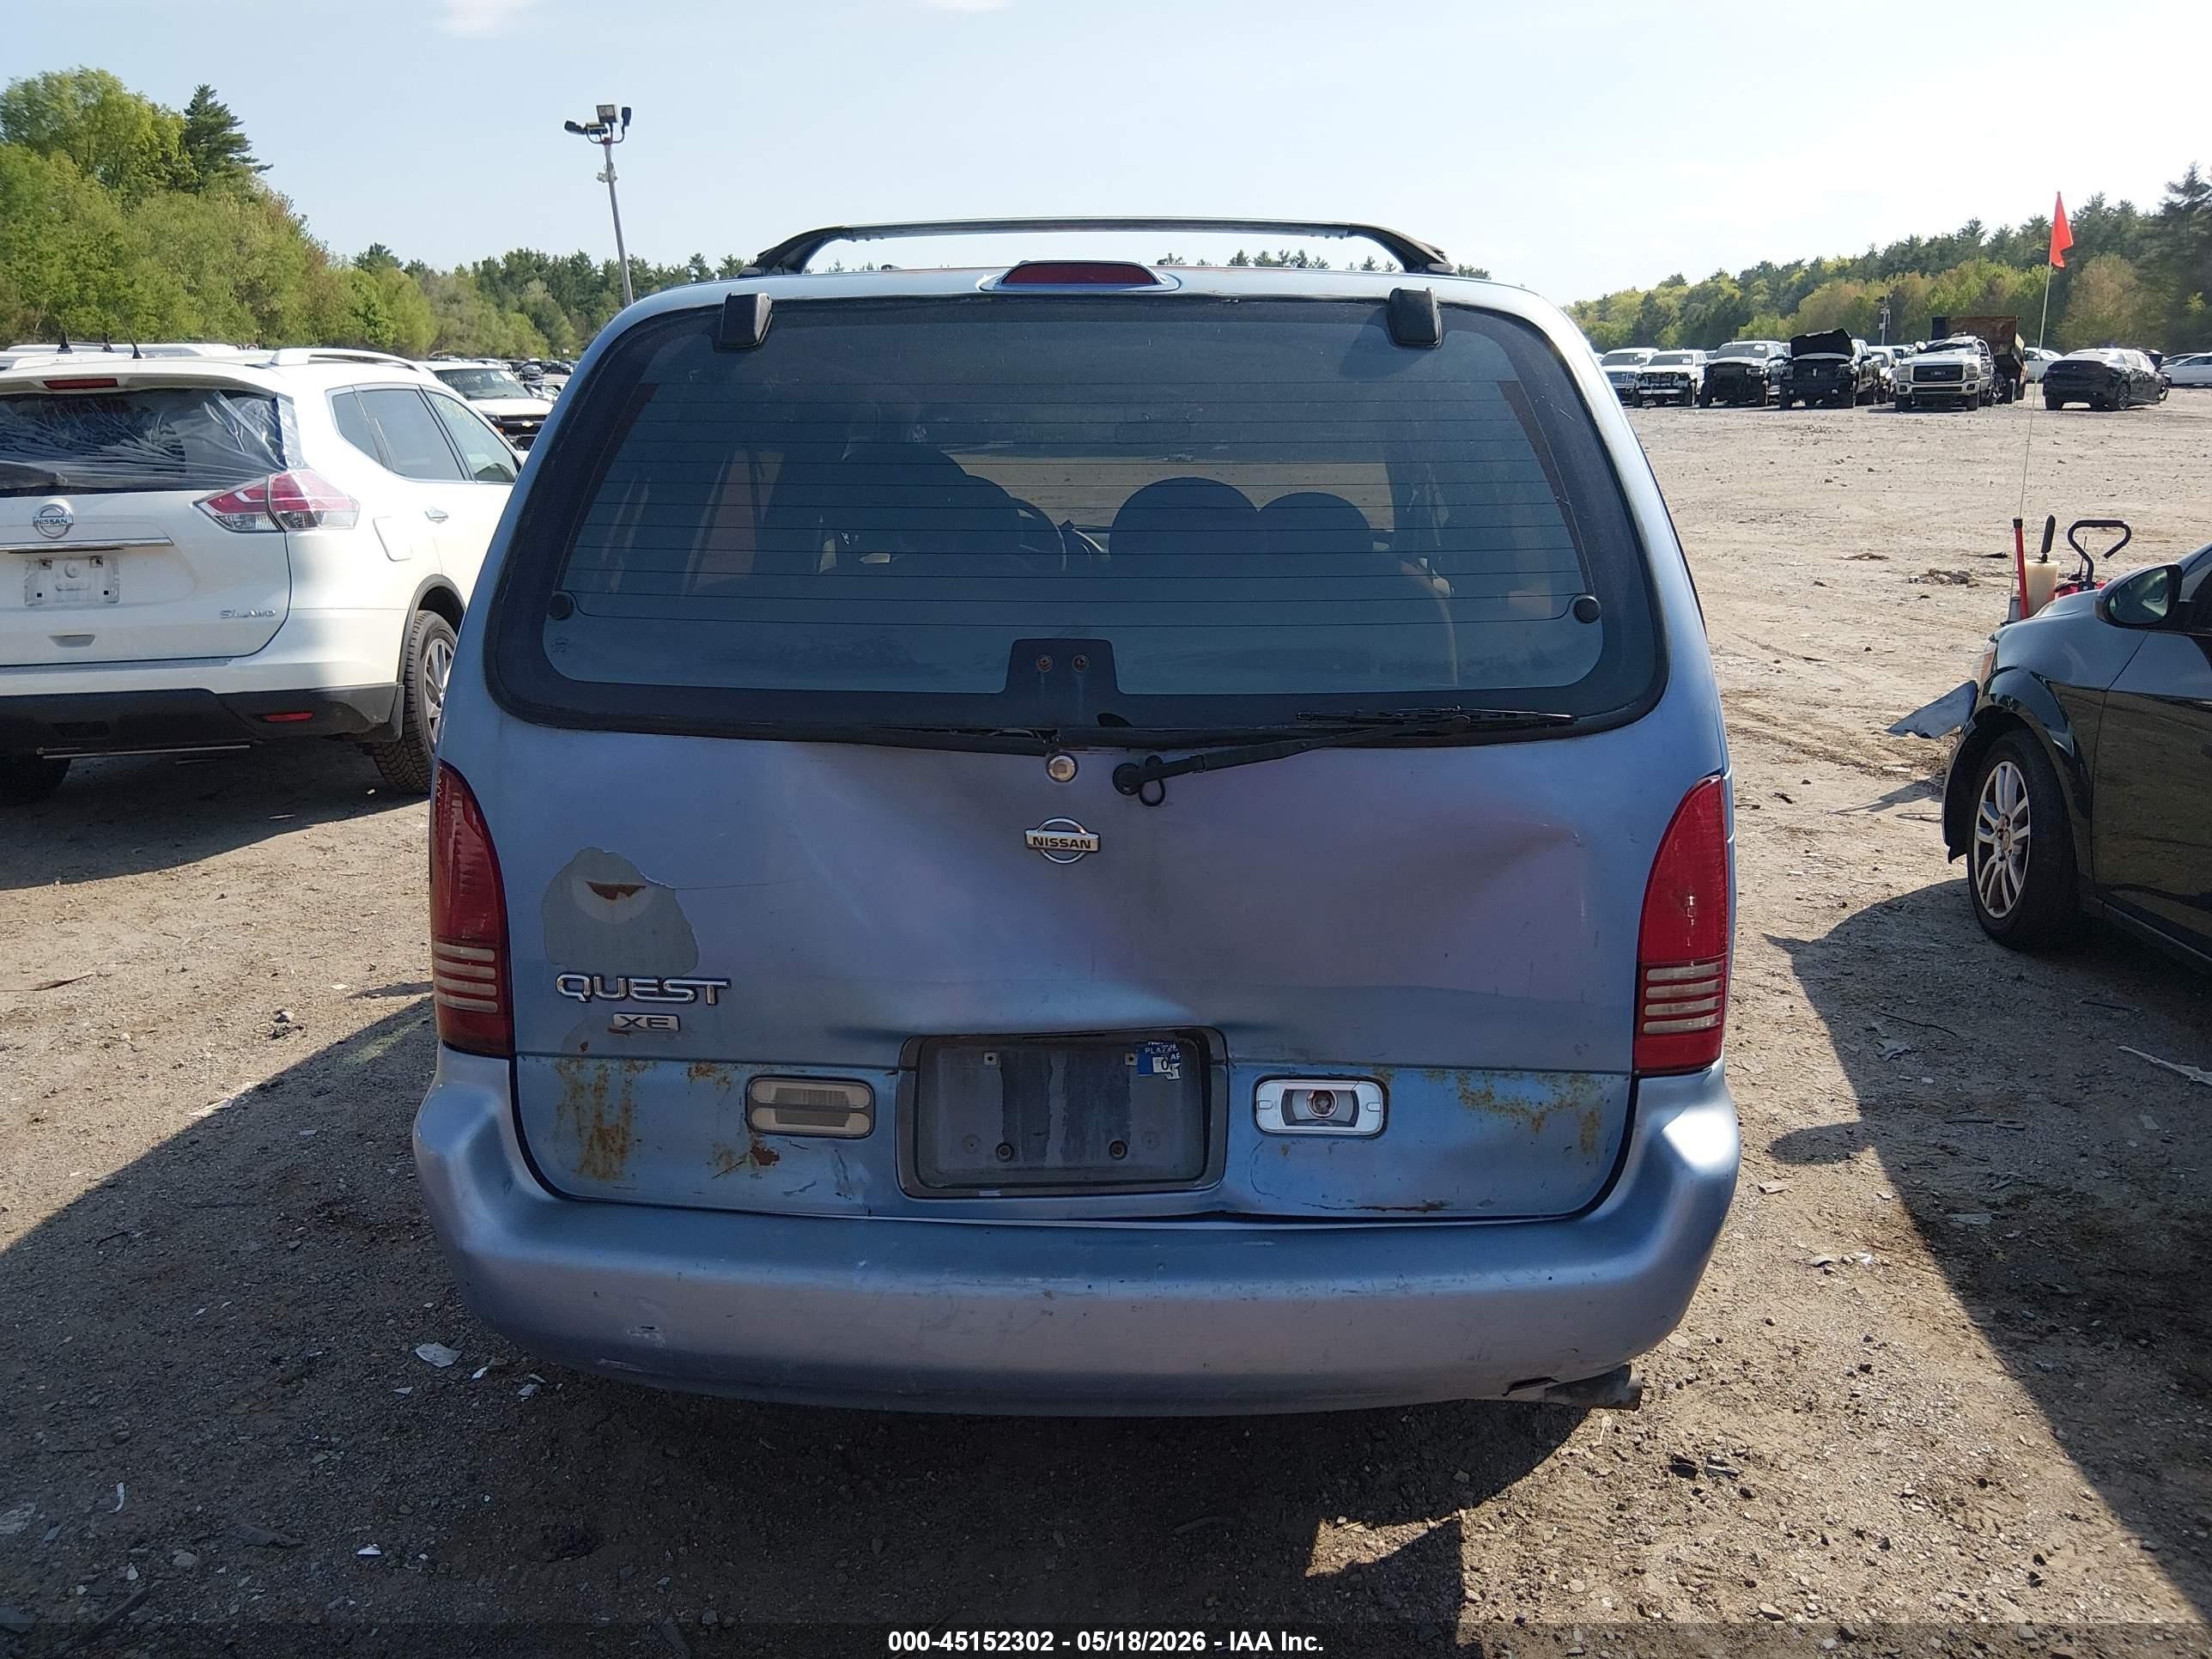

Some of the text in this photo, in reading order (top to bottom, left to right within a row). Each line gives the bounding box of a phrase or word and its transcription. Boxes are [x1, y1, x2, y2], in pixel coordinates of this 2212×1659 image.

[1033, 836, 1091, 849] NISSAN
[556, 973, 729, 1005] QUEST
[618, 1016, 671, 1030] XE
